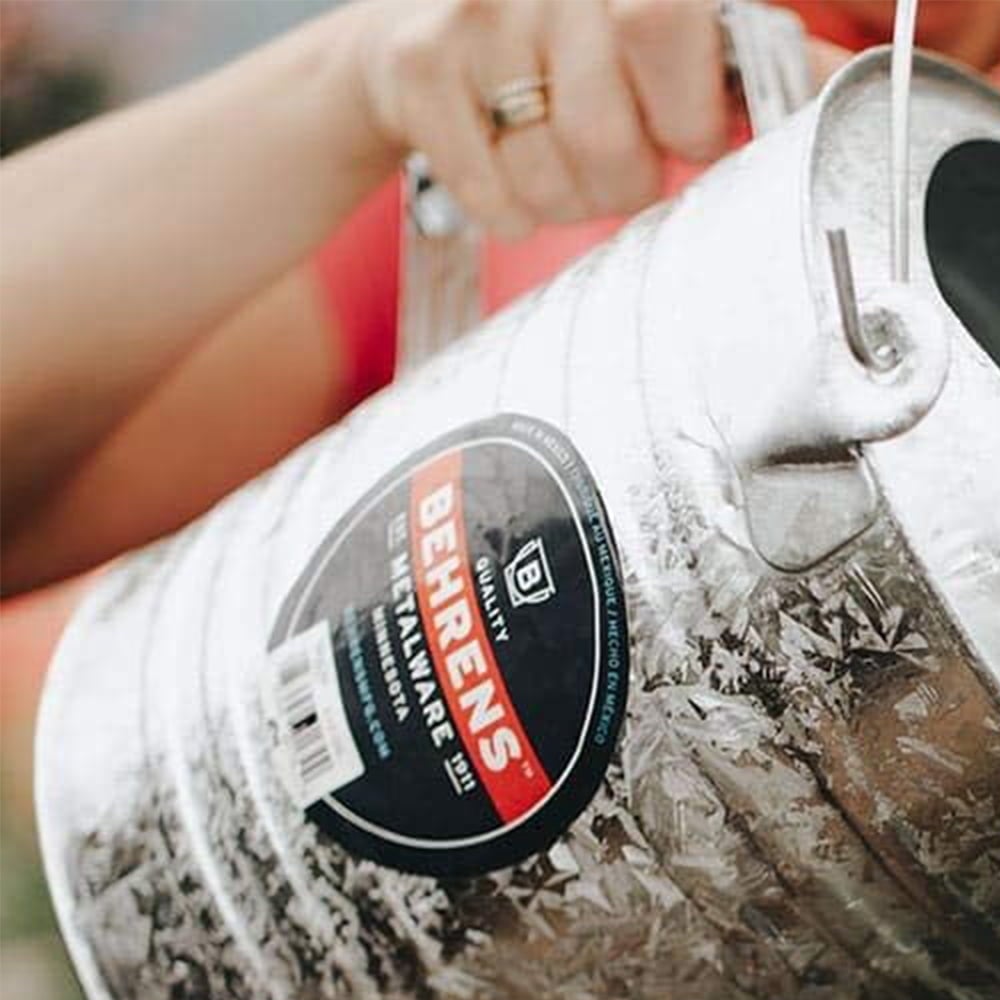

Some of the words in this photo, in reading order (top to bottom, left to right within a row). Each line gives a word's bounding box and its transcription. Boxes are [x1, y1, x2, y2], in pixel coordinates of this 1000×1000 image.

[476, 556, 509, 642] QUALITY
[516, 562, 541, 590] B
[371, 604, 411, 722] MINNESOTA
[419, 482, 522, 773] BEHRENS
[608, 620, 620, 669] HECHO
[391, 551, 454, 747] METALWARE
[451, 752, 477, 791] 1911
[608, 671, 619, 691] EN
